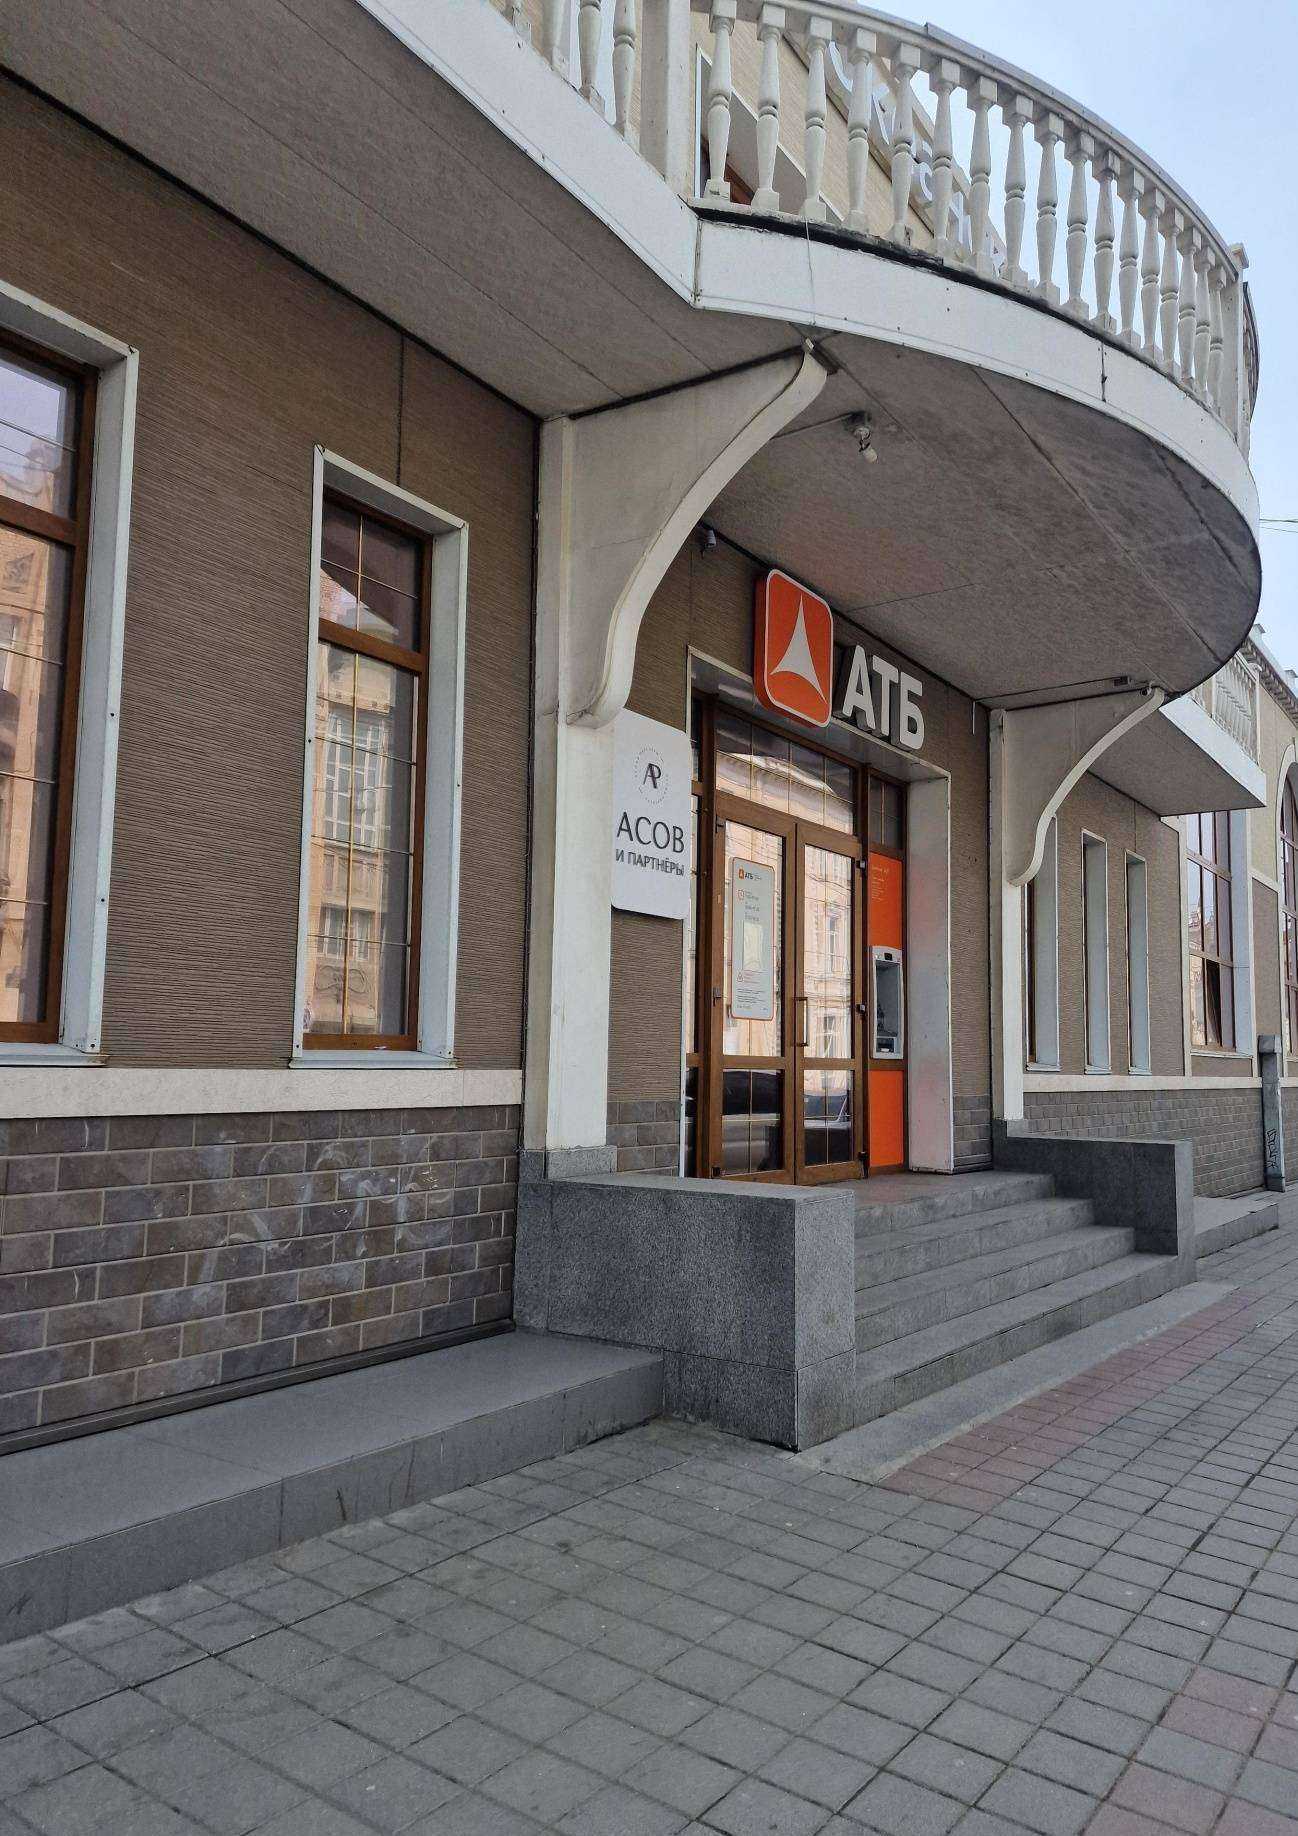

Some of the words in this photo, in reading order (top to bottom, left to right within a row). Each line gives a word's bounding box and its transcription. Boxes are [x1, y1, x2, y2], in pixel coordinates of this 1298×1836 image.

[842, 644, 925, 750] АТБ
[616, 811, 685, 853] АСОВ
[615, 849, 625, 863] И
[627, 851, 685, 877] ПАРТНЁРЫ
